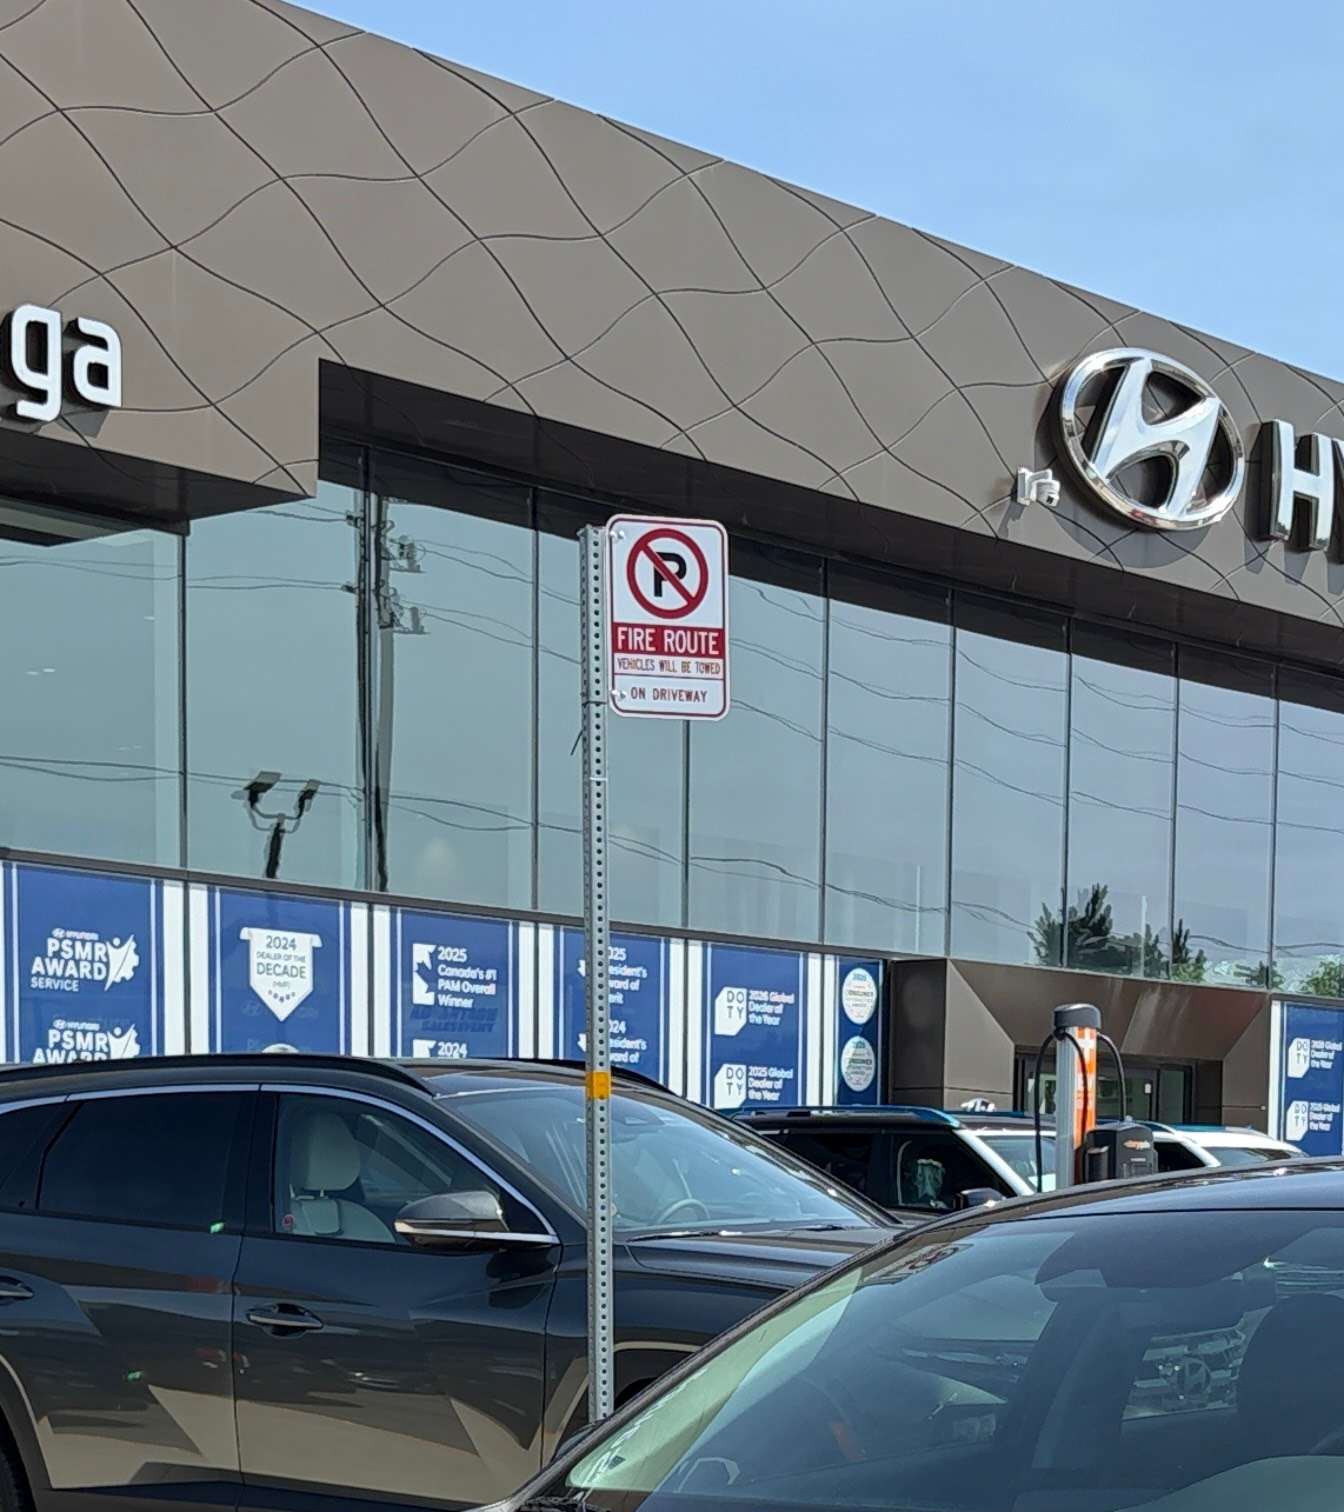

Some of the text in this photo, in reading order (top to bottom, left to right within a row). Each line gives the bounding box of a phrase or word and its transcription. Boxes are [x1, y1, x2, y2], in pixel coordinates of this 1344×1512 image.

[617, 626, 720, 655] FIRE ROUTE
[617, 657, 721, 675] VEHICLES WILL BE TOWED
[630, 686, 708, 703] ON DRIVEWAY
[46, 937, 109, 963] PSMR
[266, 935, 297, 951] 2024
[437, 946, 468, 963] 2025
[30, 955, 108, 981] AWARD
[256, 961, 307, 979] DECADE
[437, 963, 484, 980] Canada's
[30, 976, 80, 992] SERVICE
[462, 981, 497, 996] Overall
[437, 993, 475, 1009] Winner
[47, 1028, 110, 1054] PSMR
